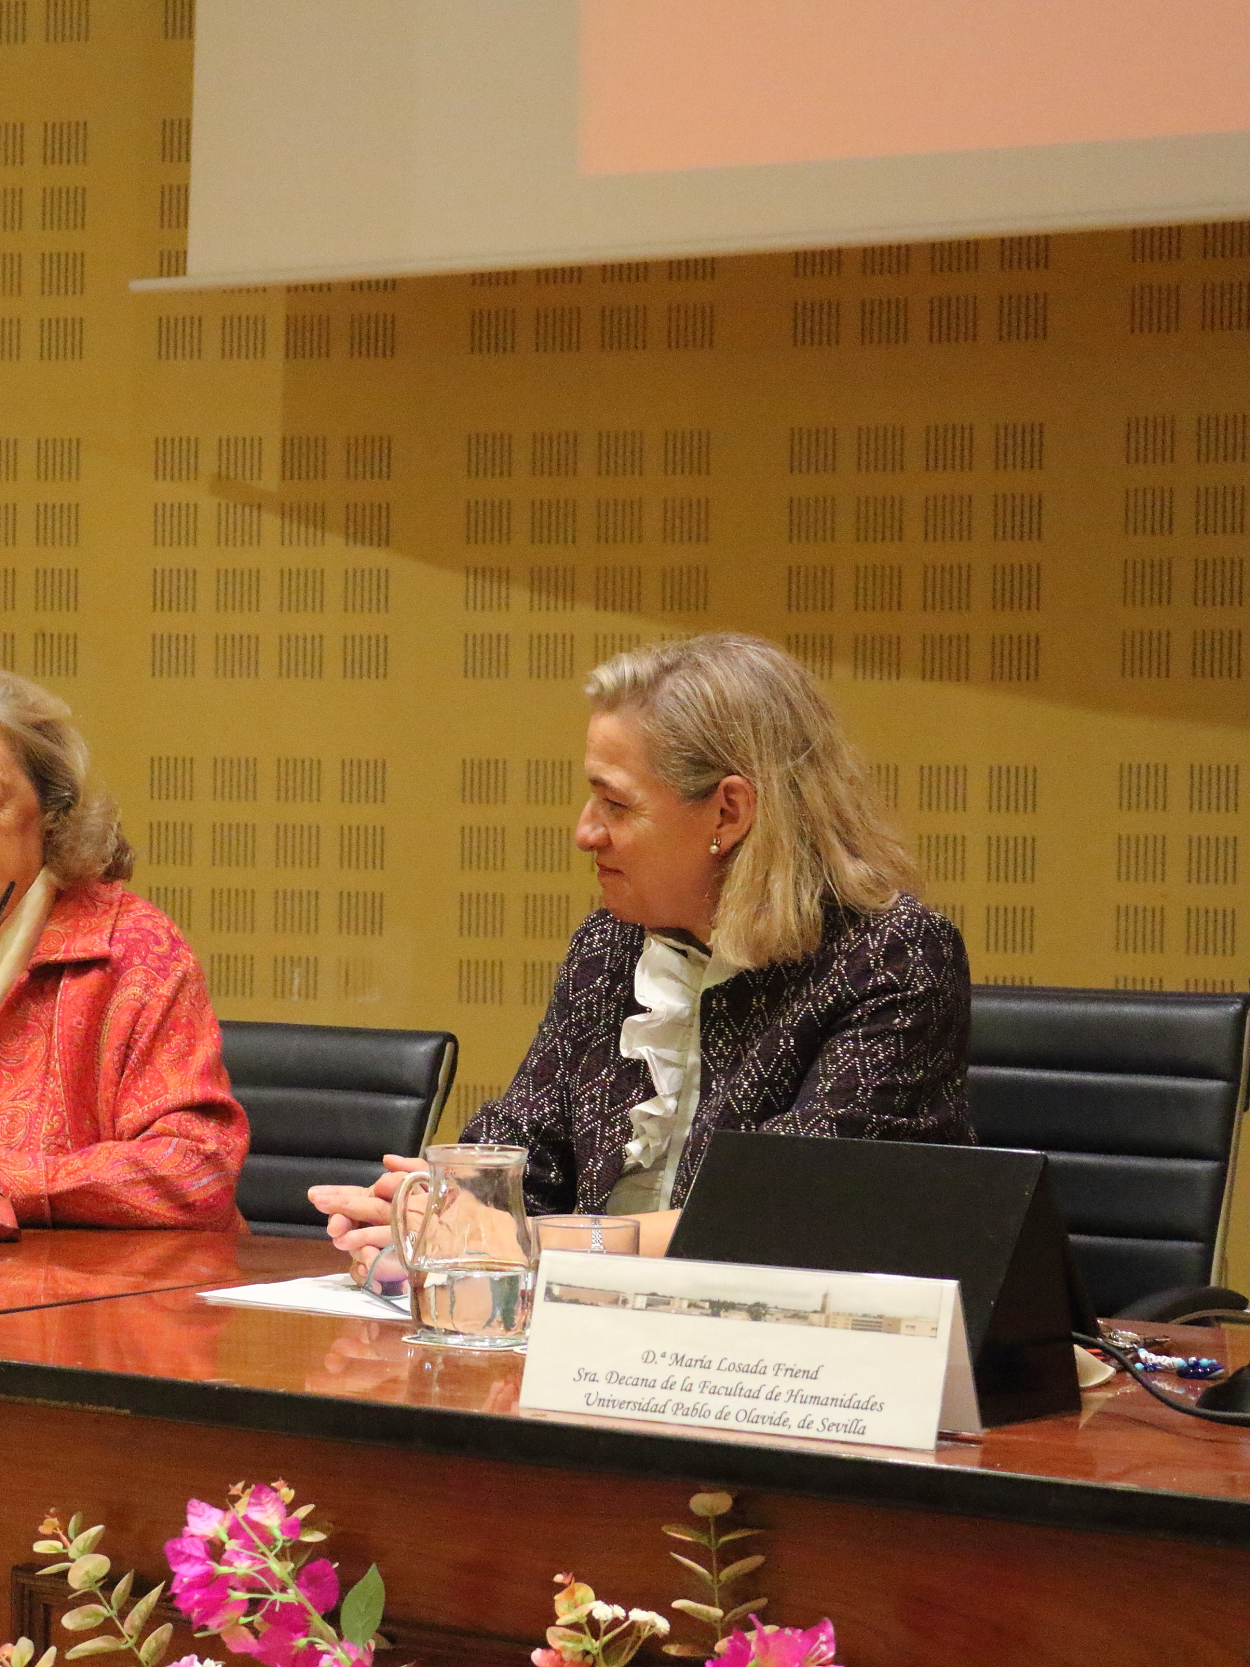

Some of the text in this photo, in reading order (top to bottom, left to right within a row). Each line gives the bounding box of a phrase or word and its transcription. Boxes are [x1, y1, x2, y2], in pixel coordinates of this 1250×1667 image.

[668, 1352, 713, 1370] María
[716, 1357, 768, 1376] Losada
[772, 1362, 825, 1380] Friend
[573, 1367, 885, 1413] Sra. Decana de la Facultad de Humanidades
[584, 1391, 867, 1436] Universidad Pablo de Olavide, de Sevilla
